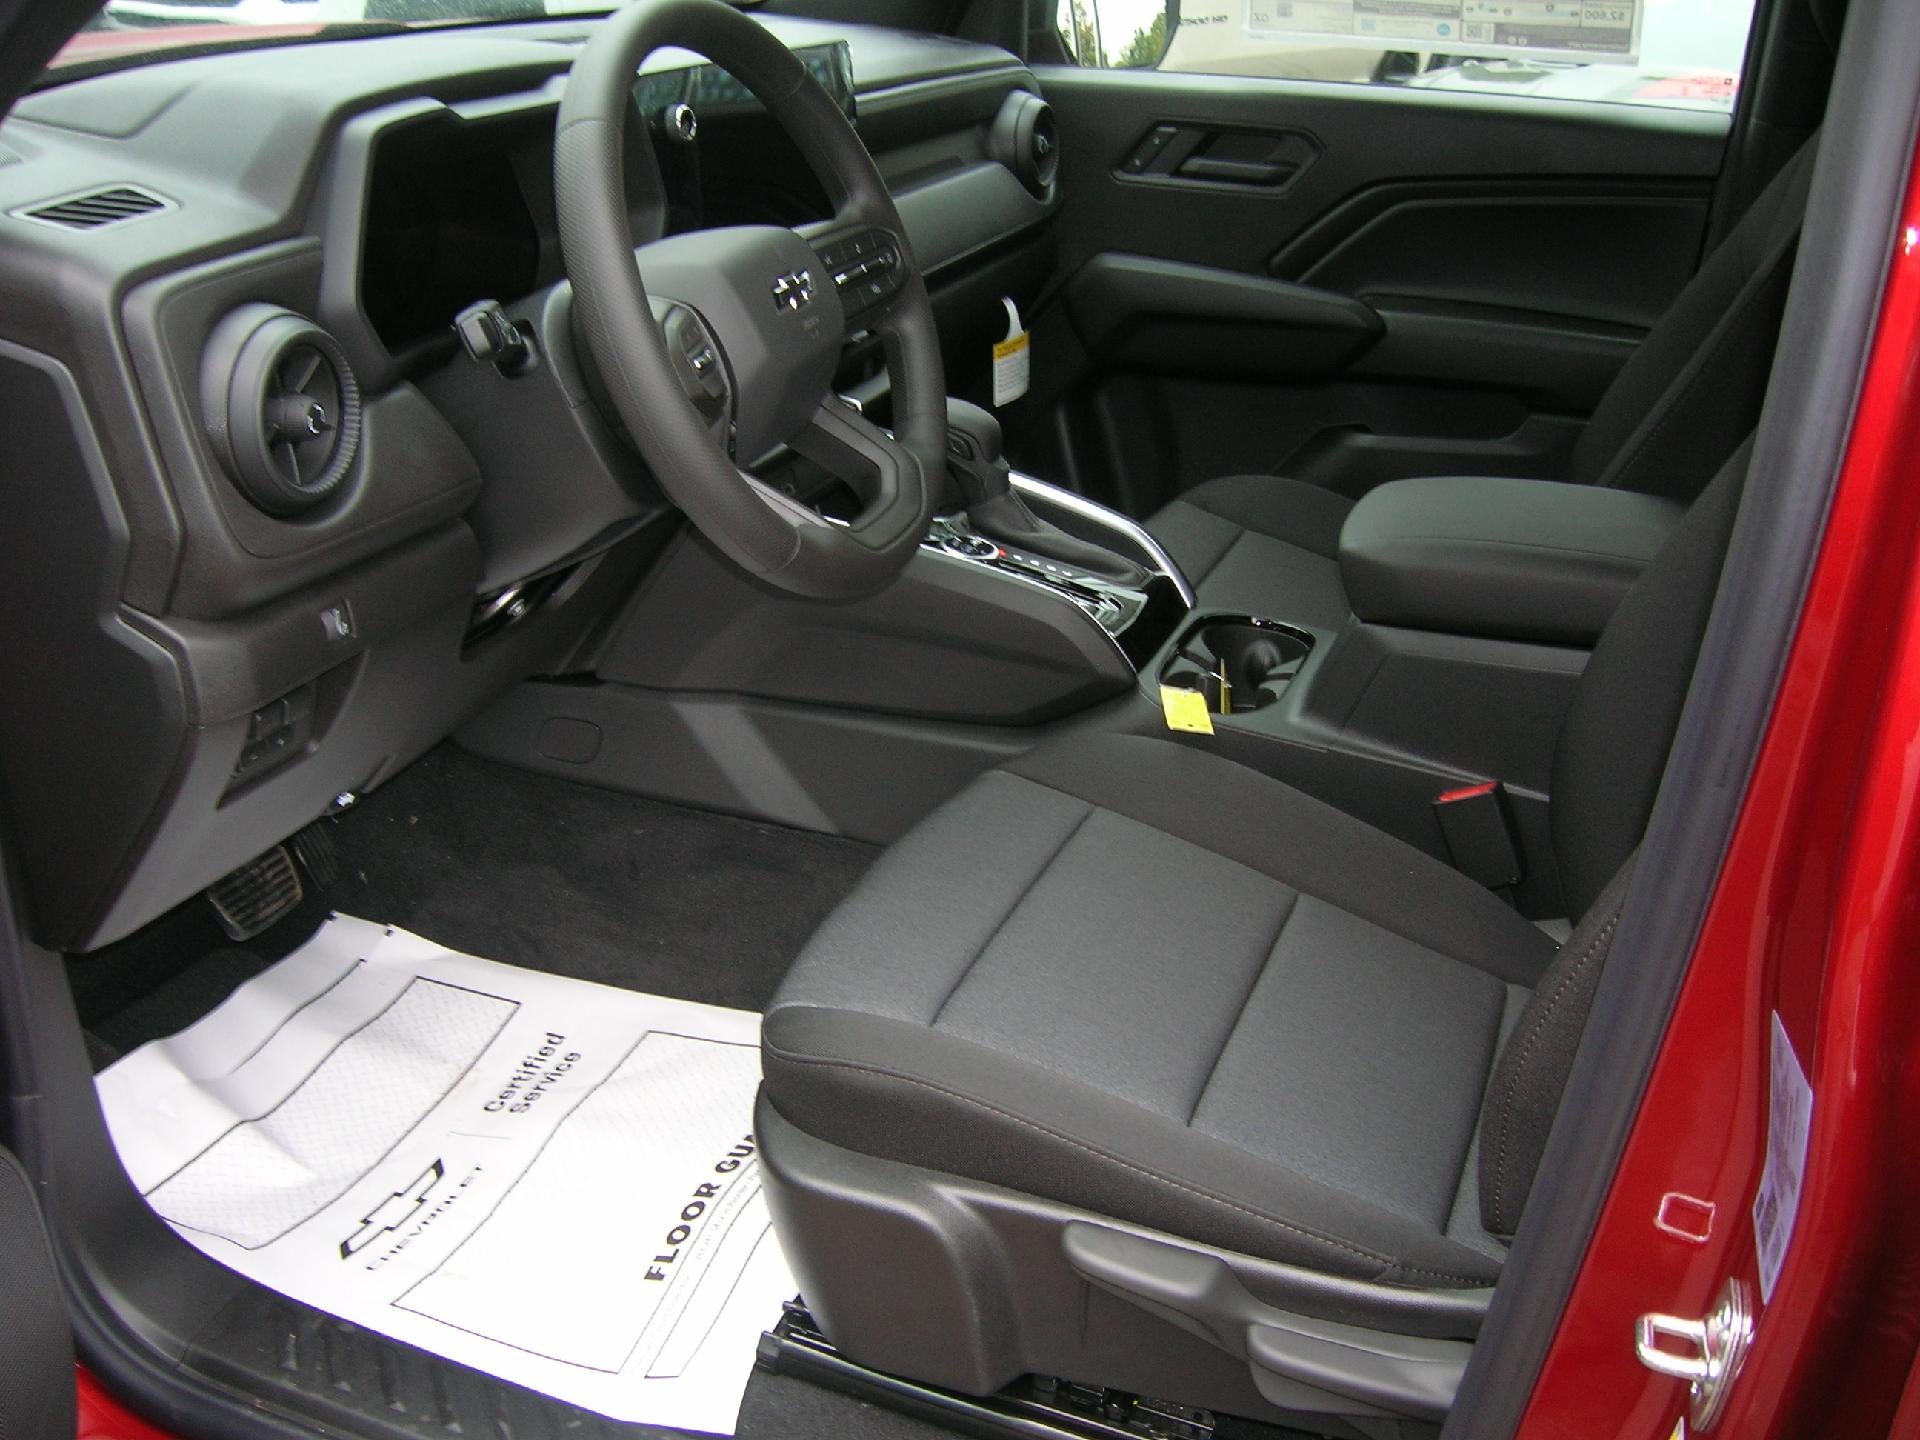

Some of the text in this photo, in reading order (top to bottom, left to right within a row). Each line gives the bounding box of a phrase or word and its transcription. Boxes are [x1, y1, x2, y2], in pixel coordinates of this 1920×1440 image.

[484, 1032, 565, 1112] Certified
[509, 1052, 582, 1113] Service
[366, 1163, 482, 1270] CHEVROLET
[644, 1183, 721, 1281] FLOOR
